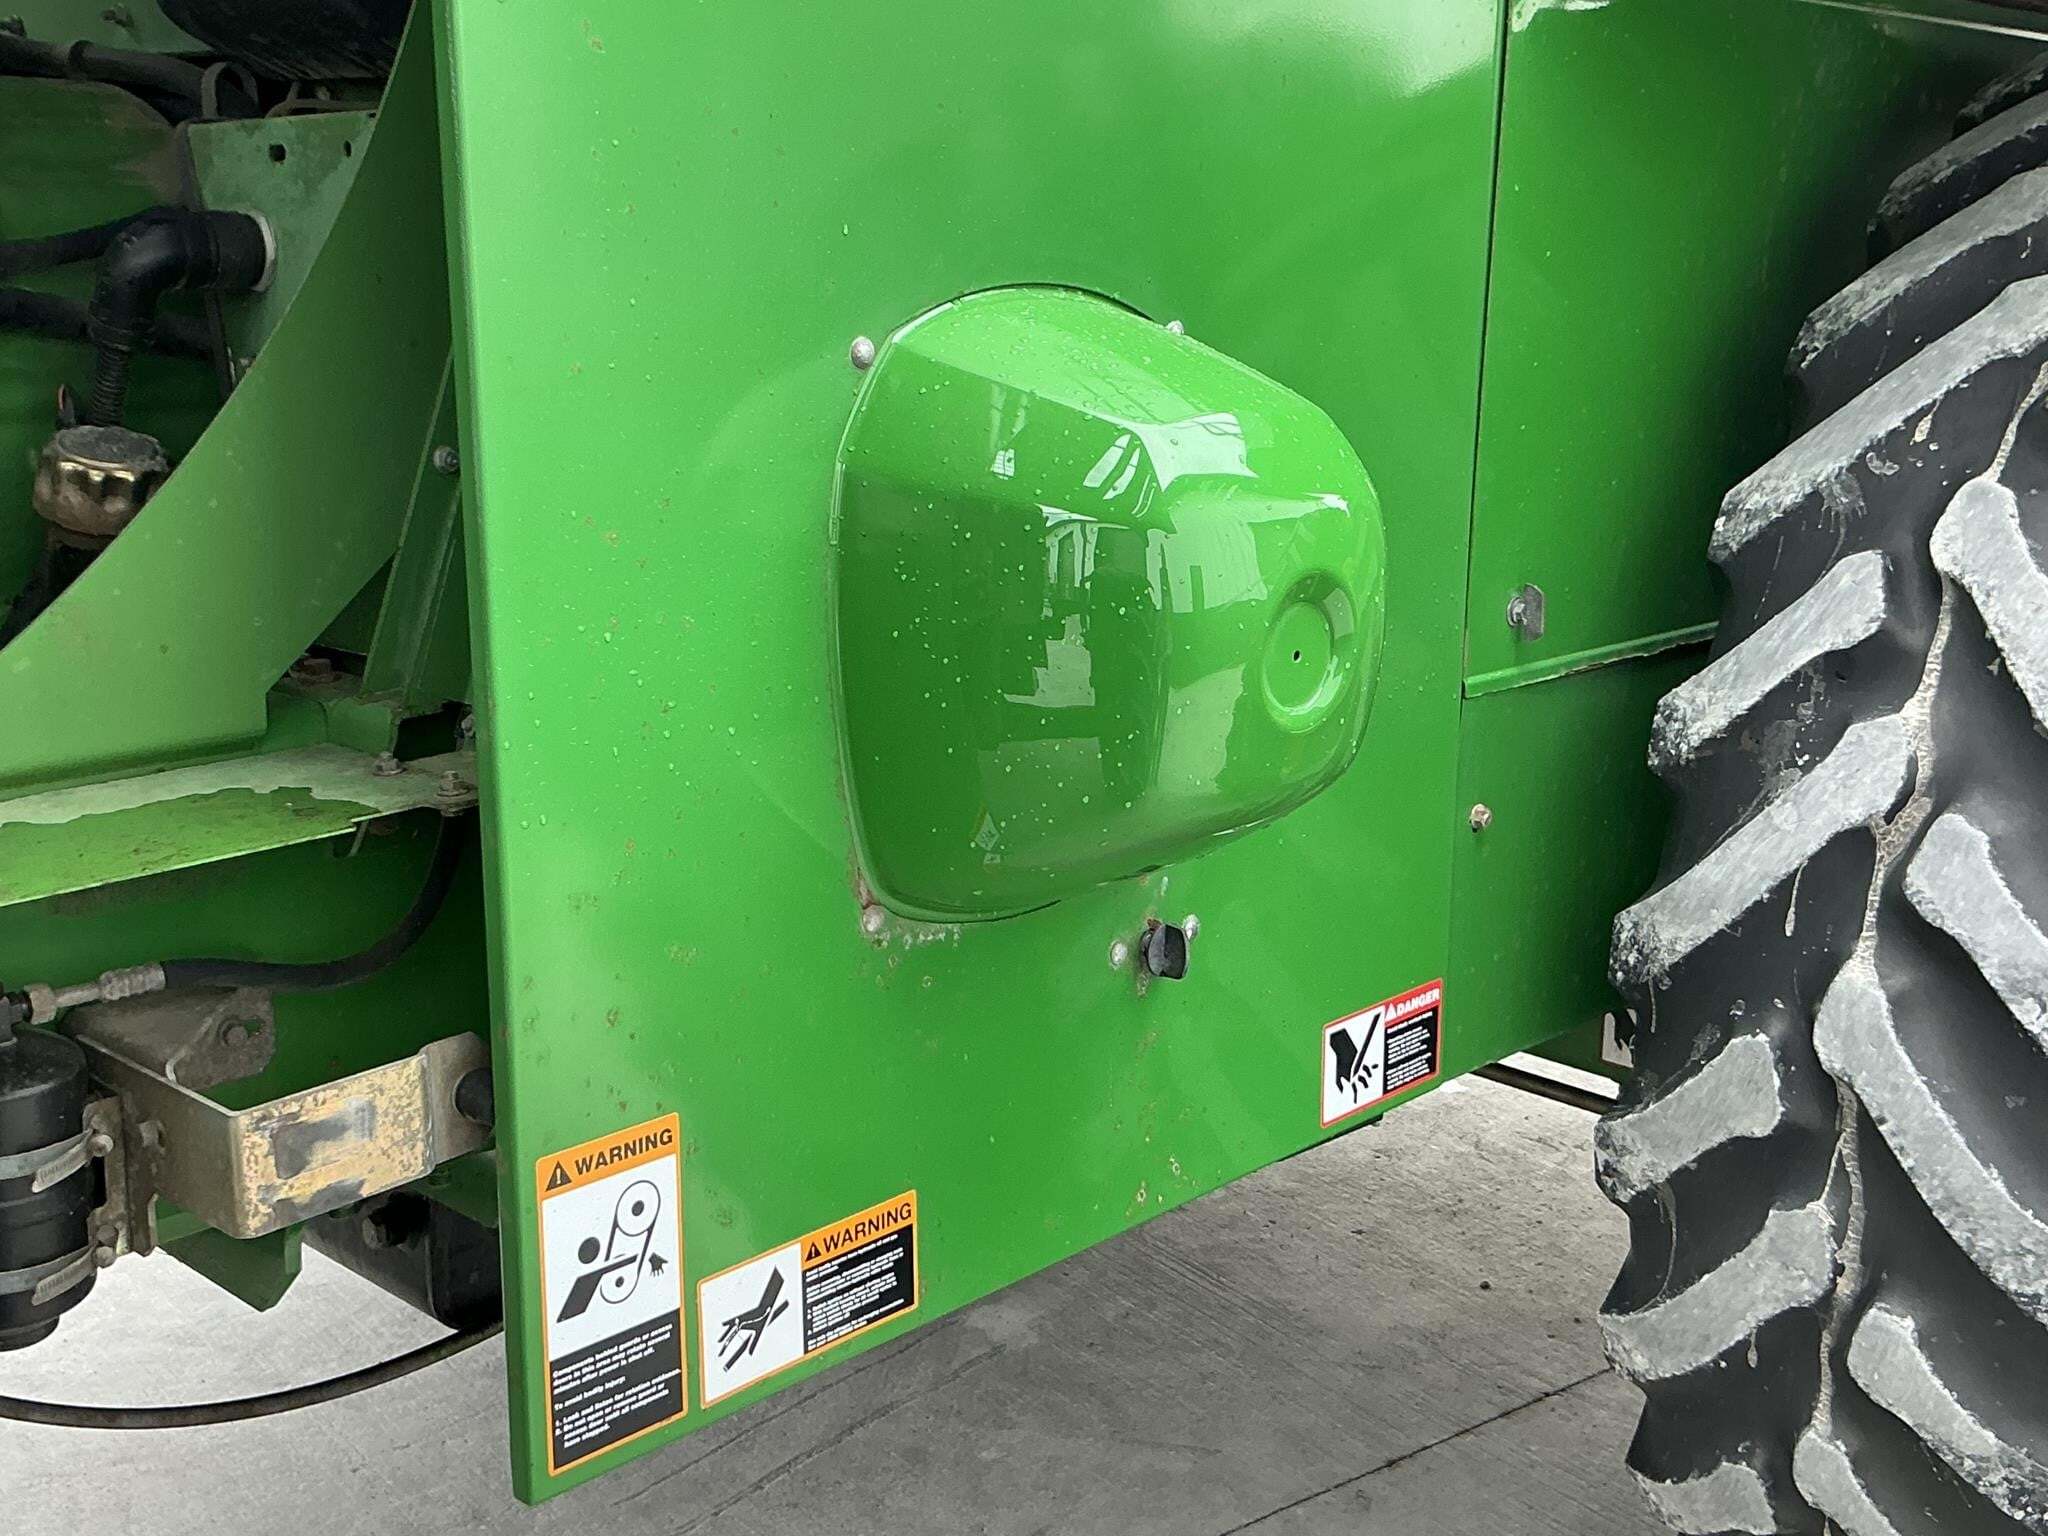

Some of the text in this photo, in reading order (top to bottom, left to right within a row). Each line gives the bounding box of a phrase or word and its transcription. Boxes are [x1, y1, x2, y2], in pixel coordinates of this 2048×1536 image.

[1397, 988, 1440, 1016] DANGER
[574, 1128, 672, 1175] WARNING
[823, 1202, 912, 1253] WARNING
